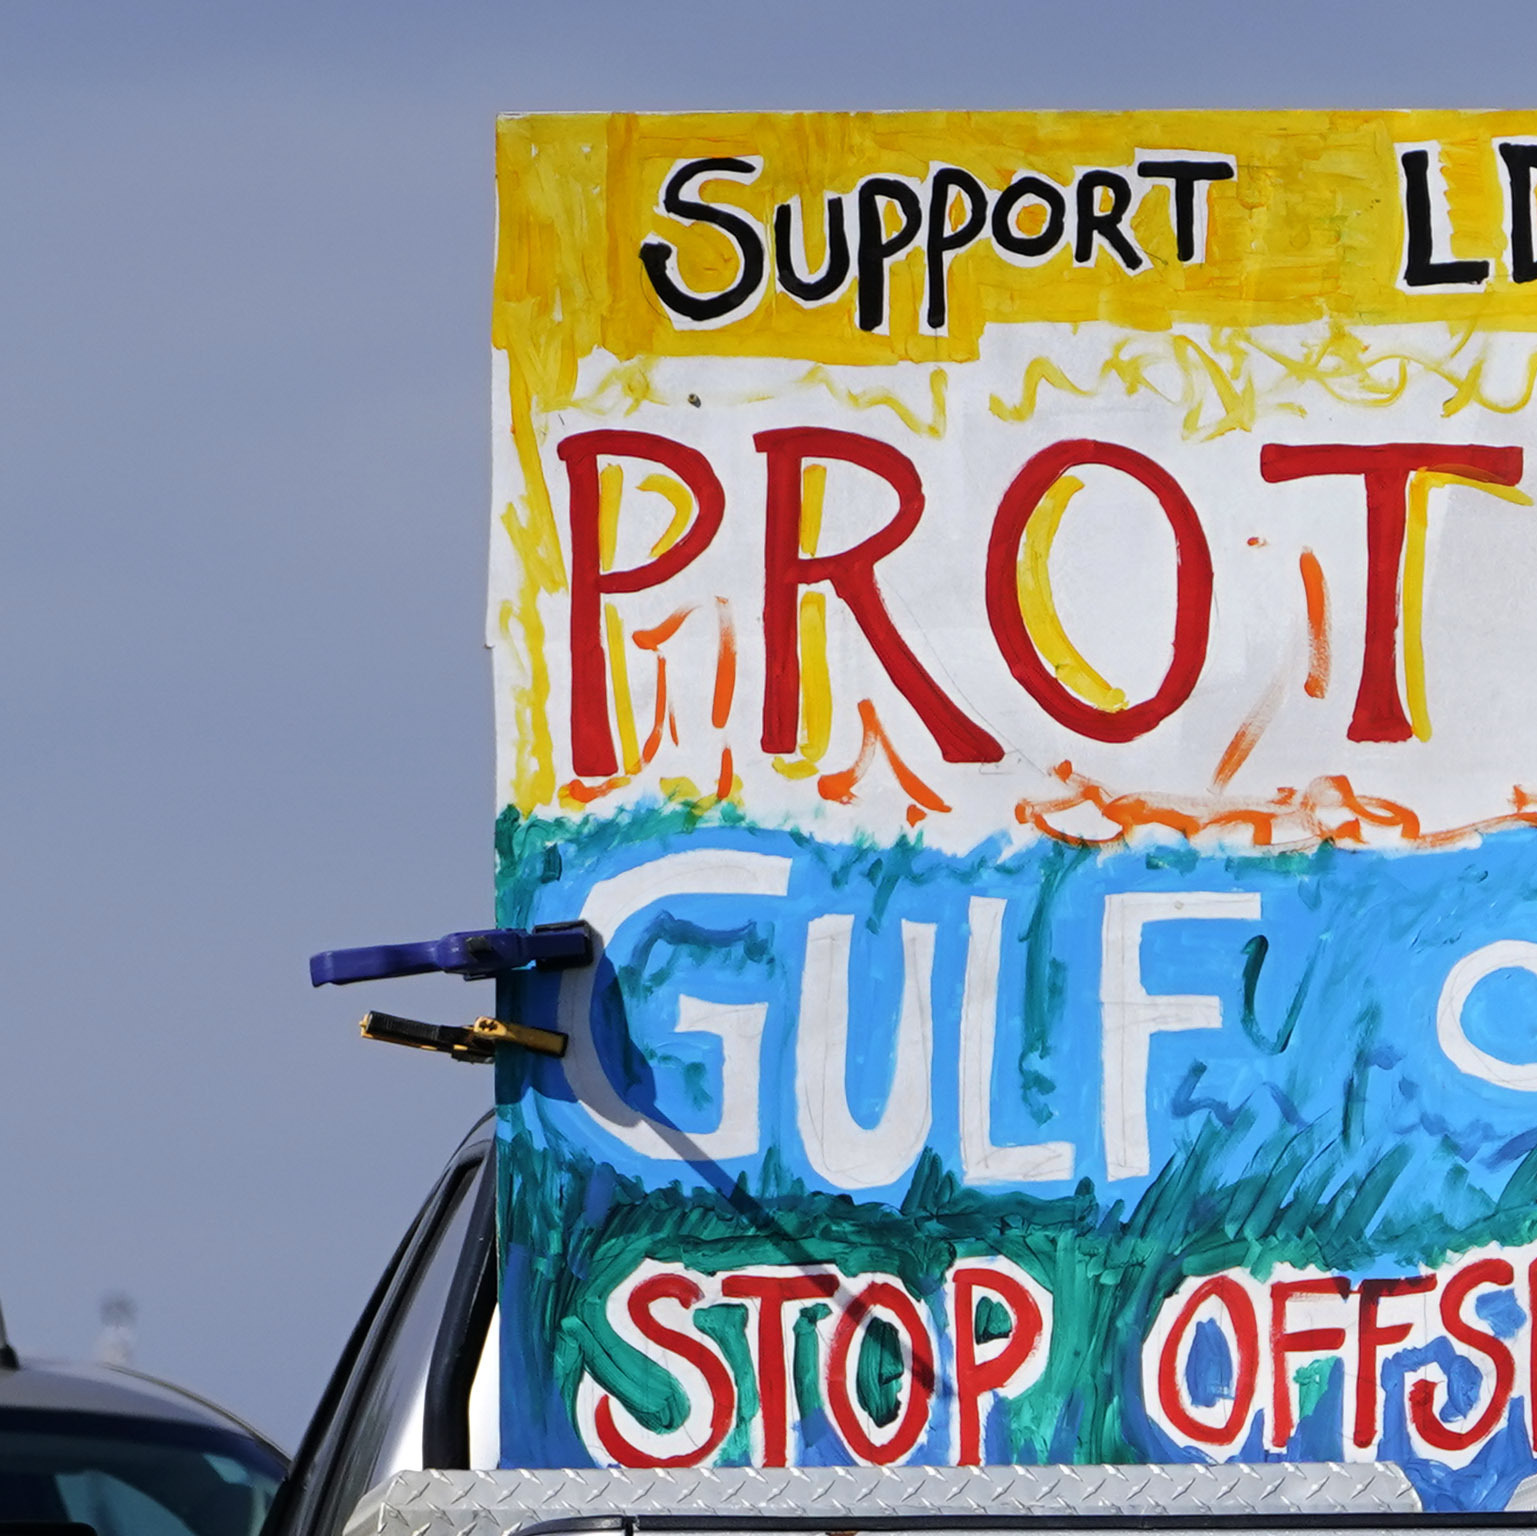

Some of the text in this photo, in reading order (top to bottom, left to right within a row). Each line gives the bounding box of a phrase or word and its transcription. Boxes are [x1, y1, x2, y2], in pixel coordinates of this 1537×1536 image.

[639, 158, 1234, 331] SUPPORT
[558, 850, 1260, 1190] GULF
[595, 1267, 1044, 1468] STOP
